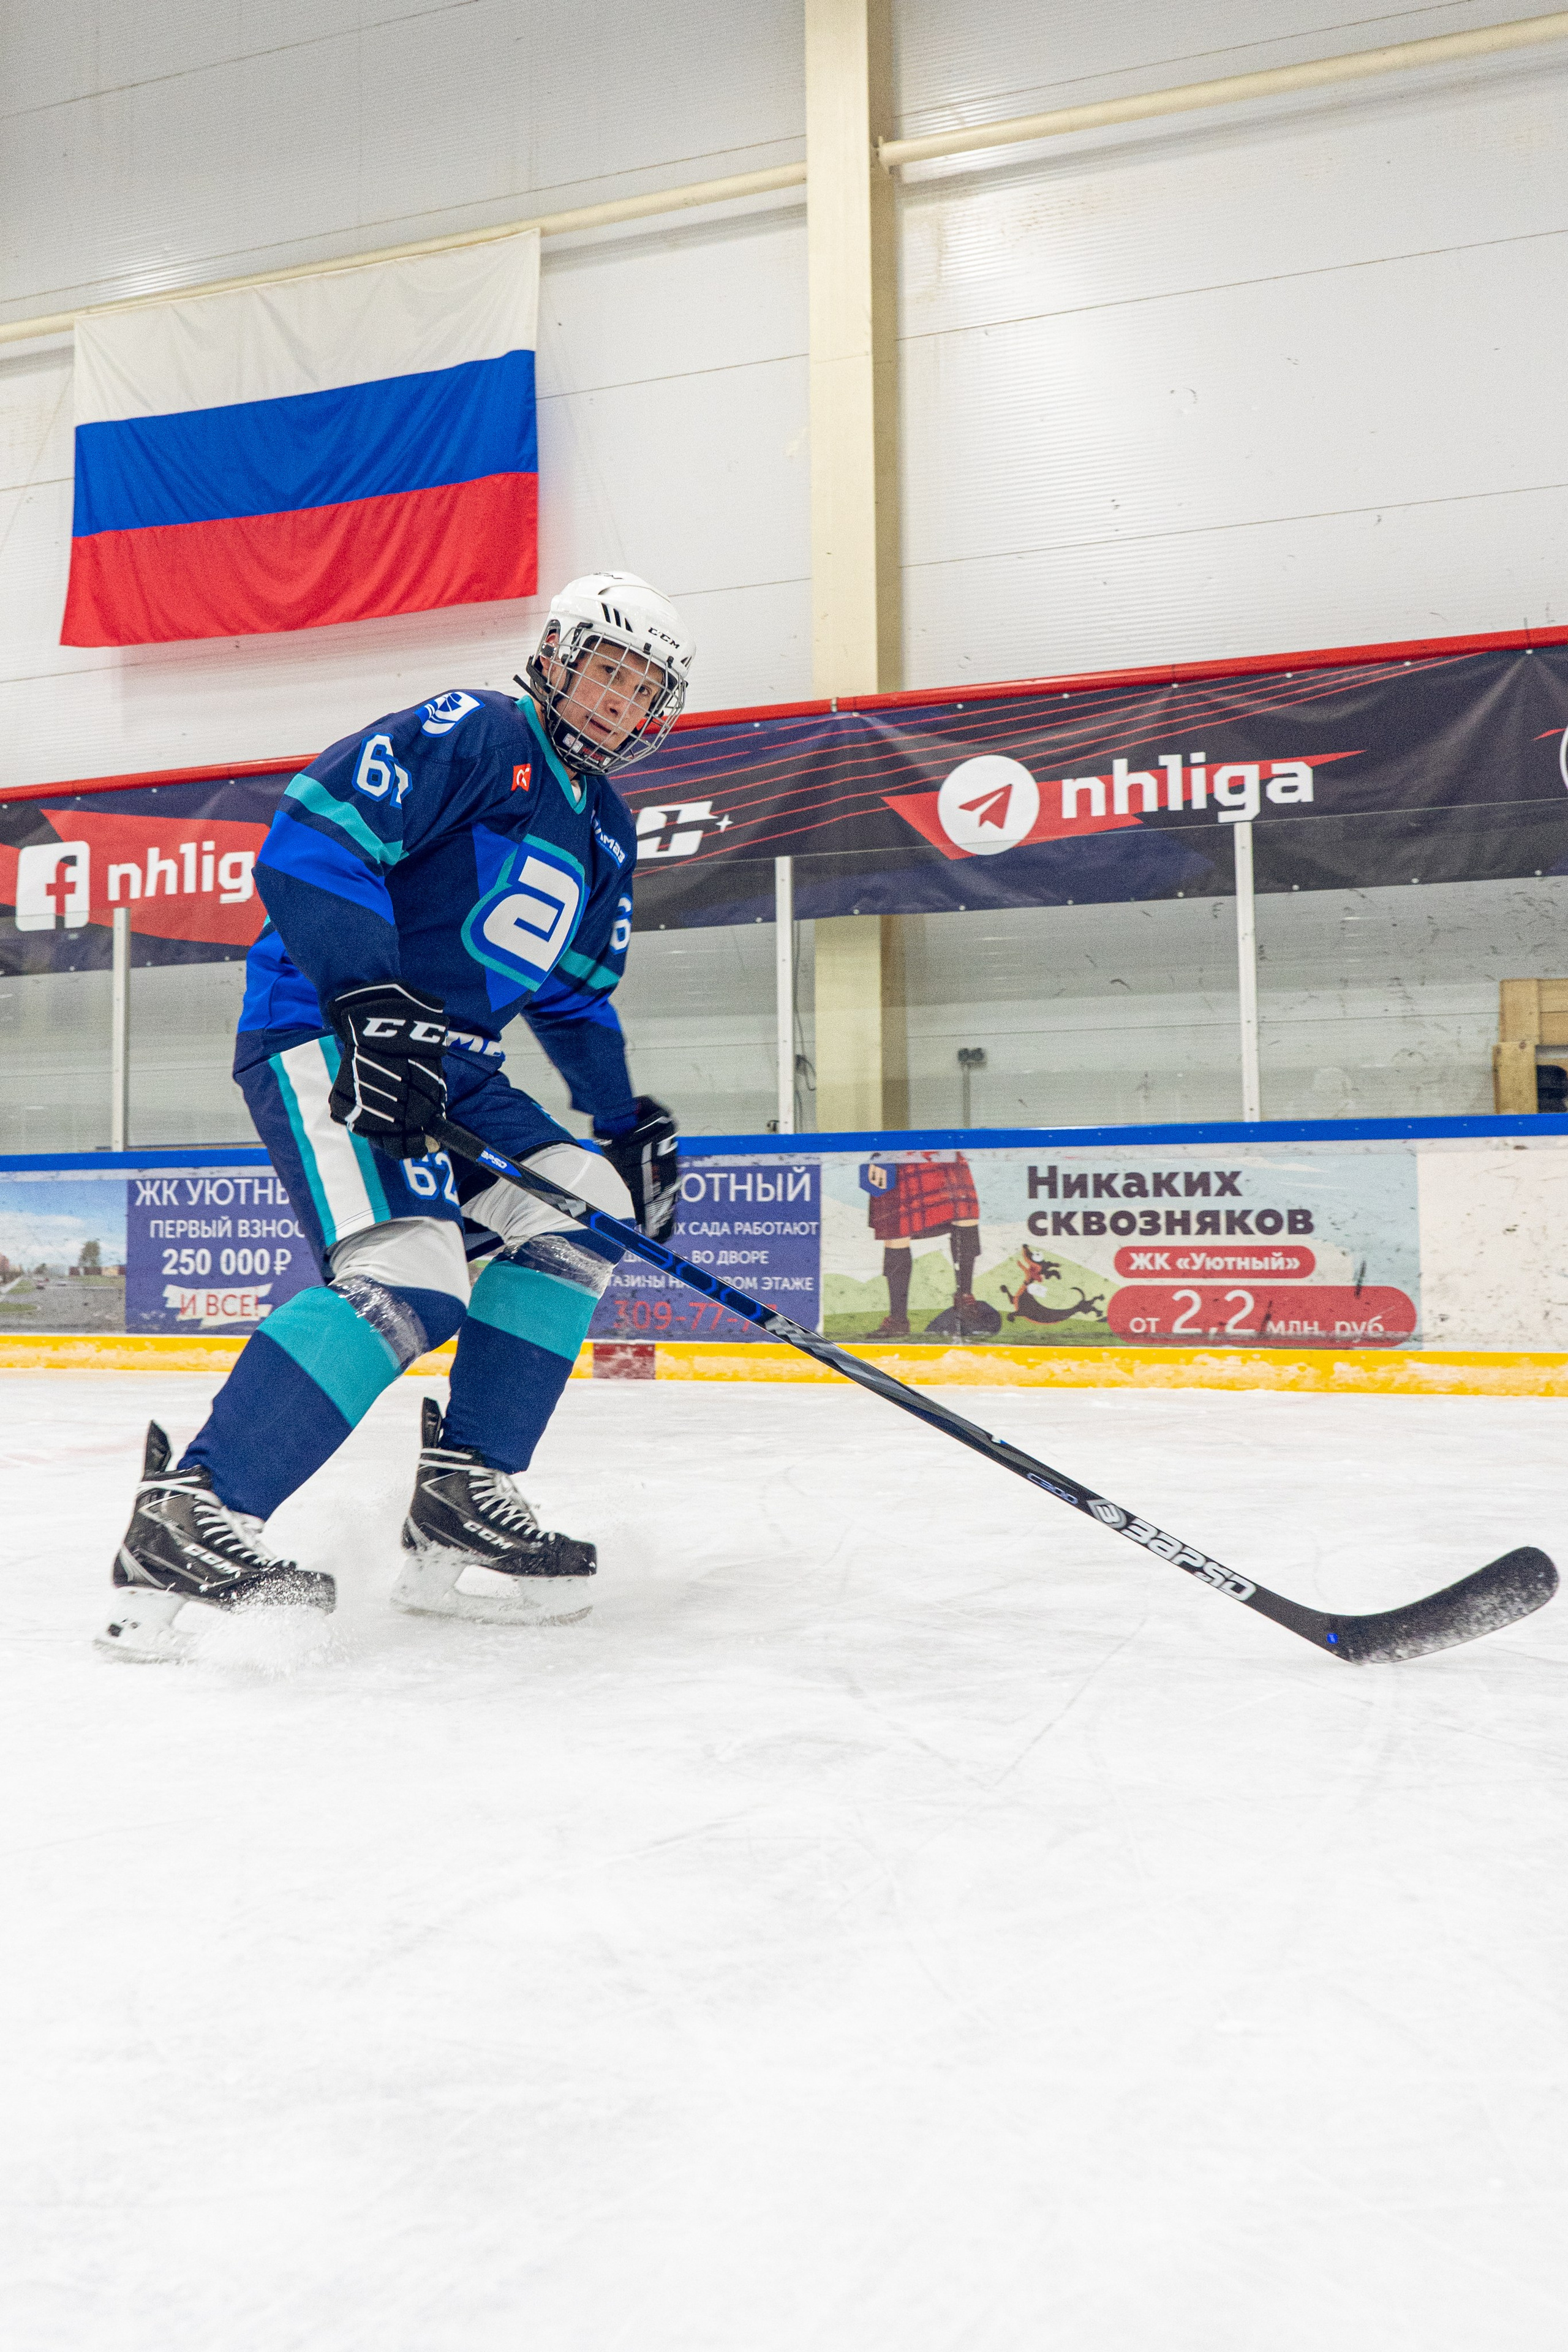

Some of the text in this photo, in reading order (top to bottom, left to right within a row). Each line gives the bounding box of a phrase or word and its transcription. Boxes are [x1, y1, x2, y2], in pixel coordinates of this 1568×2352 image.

[648, 627, 680, 649] CCM
[1062, 752, 1314, 823] nhliga
[108, 841, 255, 904] nhlig
[363, 1017, 448, 1047] CC
[135, 1178, 290, 1206] ЖК УЮТН
[403, 1152, 460, 1205] 62
[1027, 1166, 1243, 1199] Никаких
[149, 1215, 232, 1238] ПЕРВЫЙ
[688, 1221, 731, 1236] САДА
[734, 1221, 819, 1235] РАБОТАЮТ
[1027, 1208, 1314, 1237] сквозняков
[162, 1248, 212, 1275] 250
[692, 1250, 770, 1265] ВО ДВОРЕ
[1129, 1252, 1300, 1270] ЖК «Уютный»
[761, 1276, 814, 1291] ЭТАЖЕ
[180, 1294, 259, 1316] И ВСЕ!
[1129, 1317, 1160, 1333] от
[1171, 1289, 1256, 1341] 2,2
[464, 1521, 513, 1550] CCM
